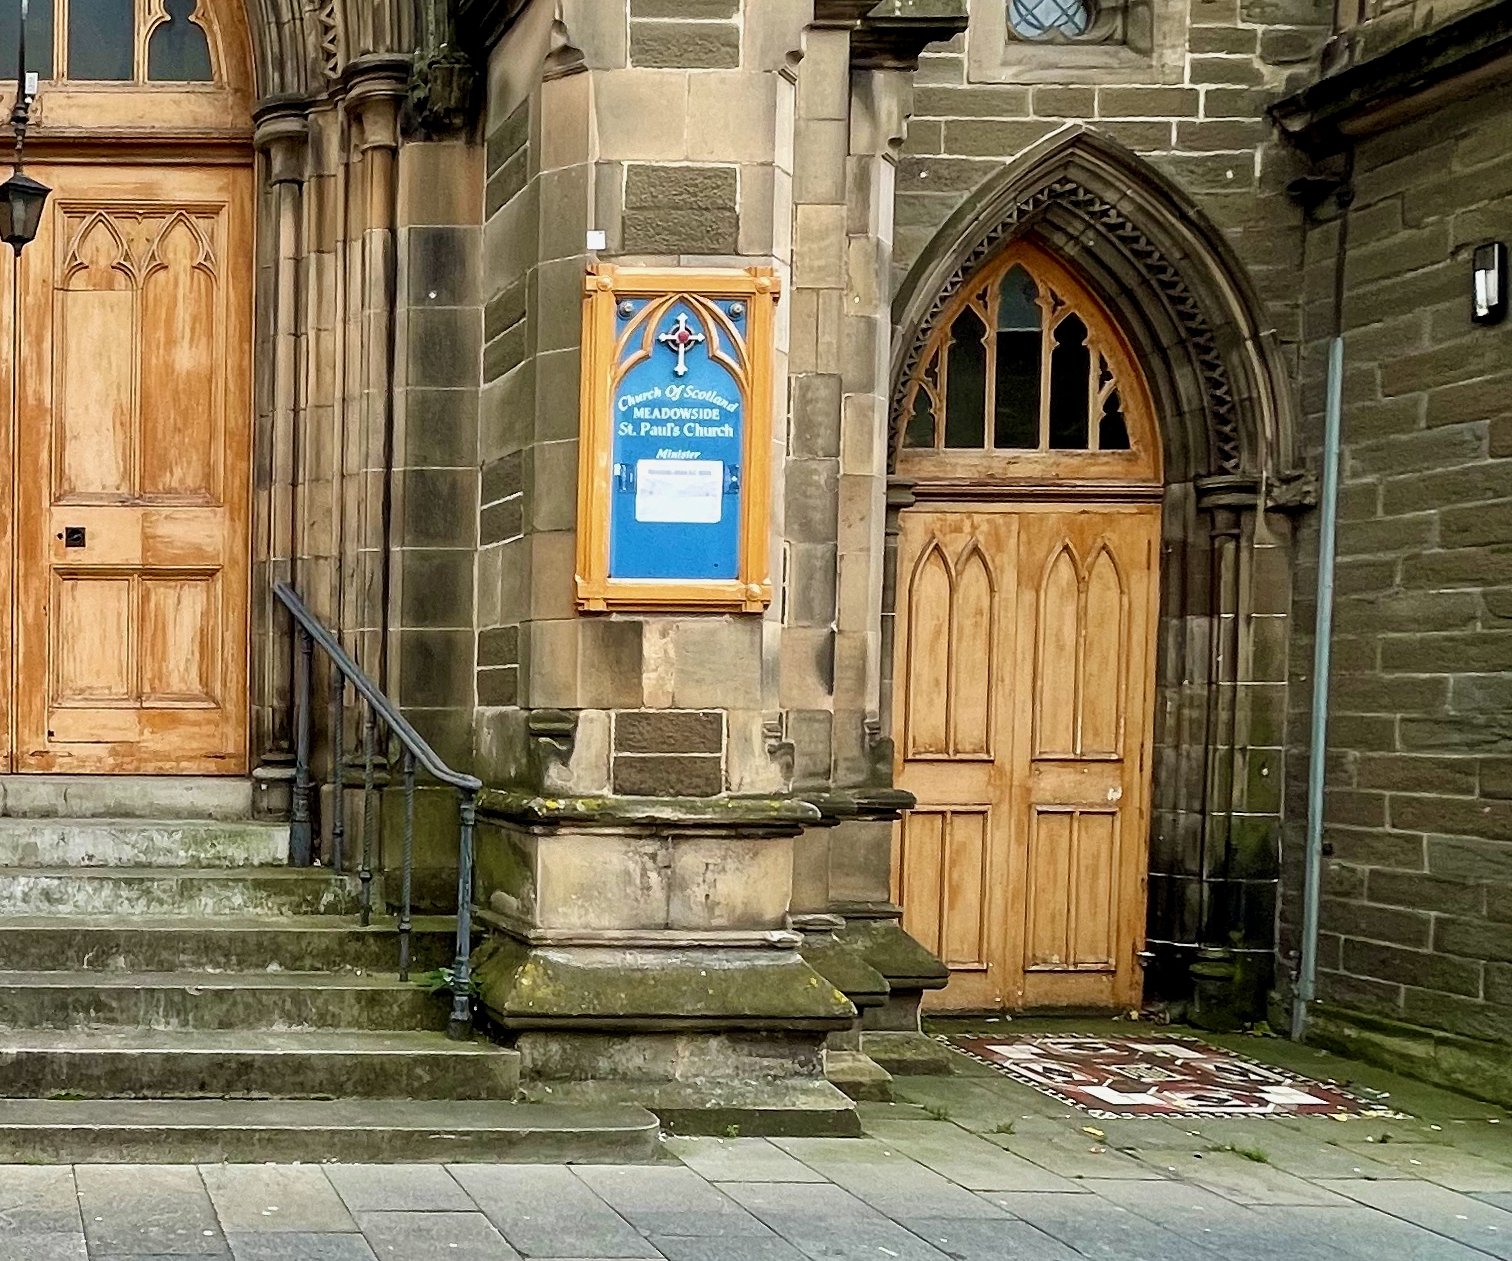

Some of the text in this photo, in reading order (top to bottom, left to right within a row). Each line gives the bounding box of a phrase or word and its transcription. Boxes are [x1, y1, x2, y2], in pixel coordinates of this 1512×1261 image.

[618, 384, 740, 413] Church Of Scotland
[633, 407, 720, 420] MEADOWSIDE
[618, 422, 734, 438] St. Paul's Church
[655, 448, 702, 460] Minister
